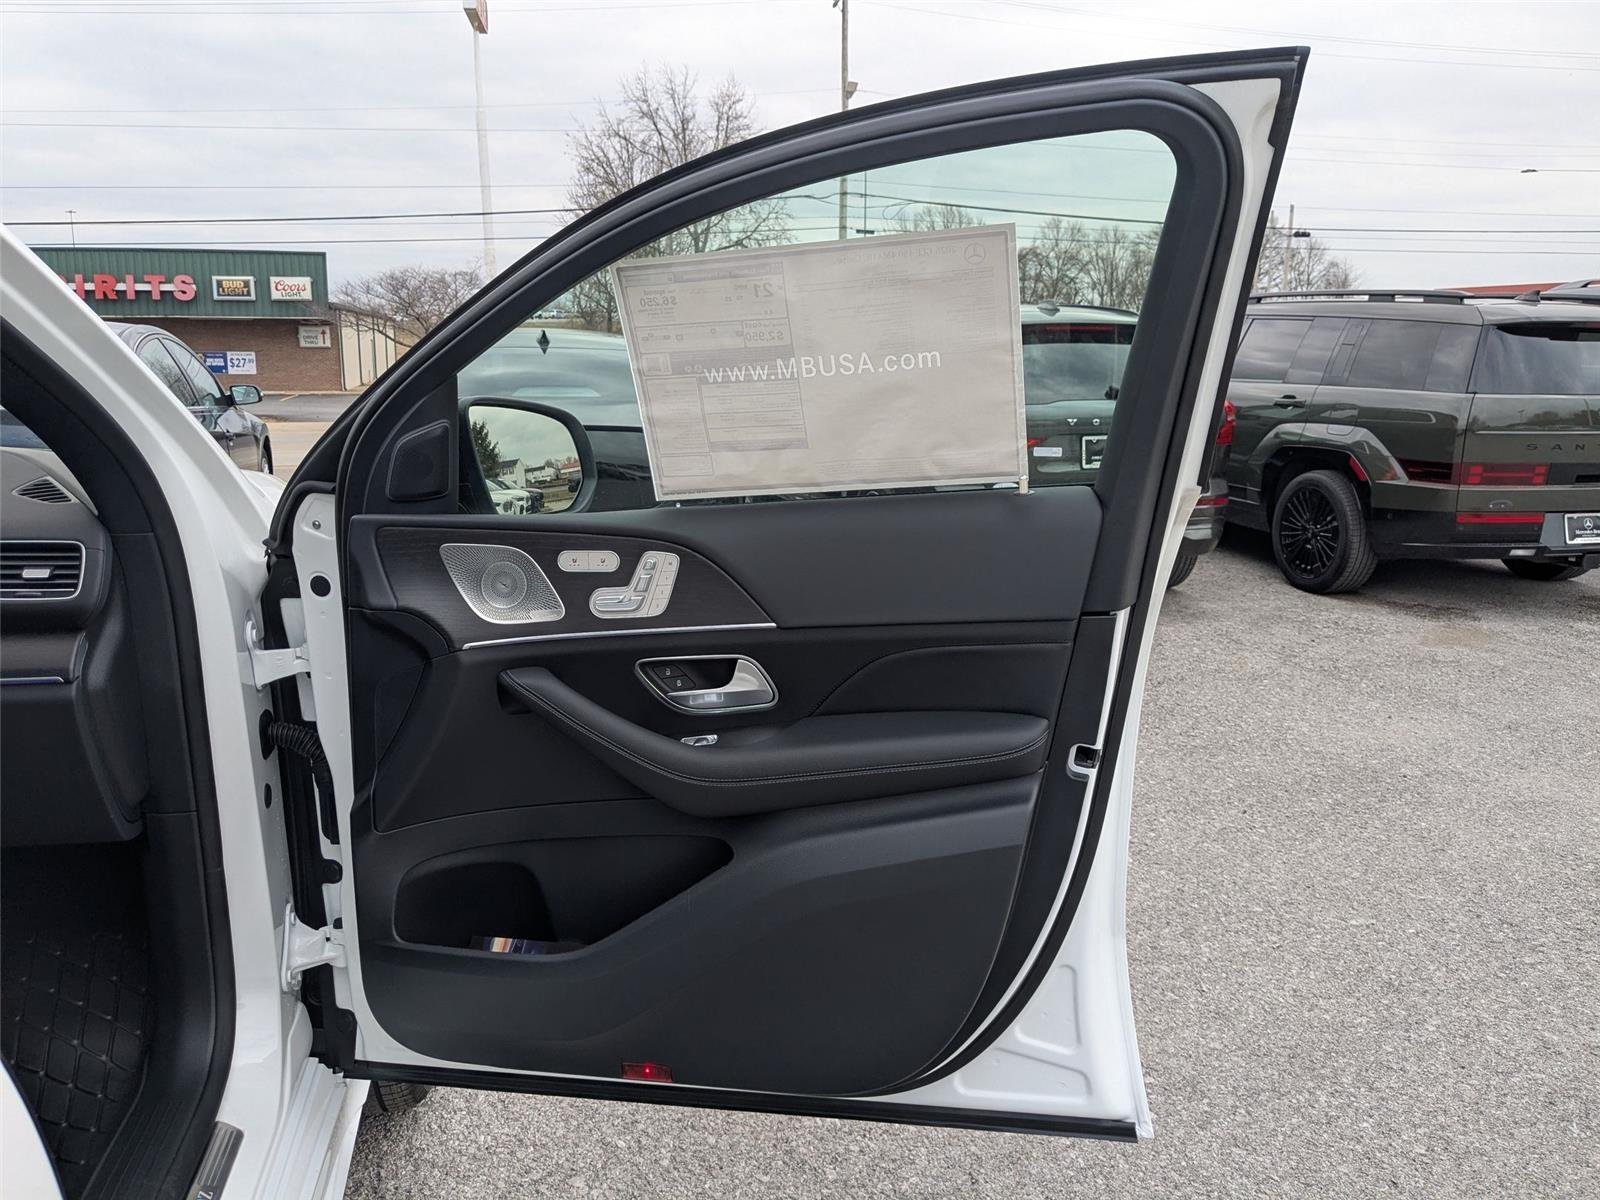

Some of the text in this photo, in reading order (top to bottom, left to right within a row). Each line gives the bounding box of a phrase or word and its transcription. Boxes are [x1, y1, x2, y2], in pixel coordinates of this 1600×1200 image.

[60, 273, 197, 301] IRITS
[221, 280, 245, 288] BUD
[273, 279, 307, 292] Coors
[218, 287, 249, 296] LIGHT
[703, 351, 942, 384] www.MBUSA.com
[1527, 443, 1600, 451] SAN
